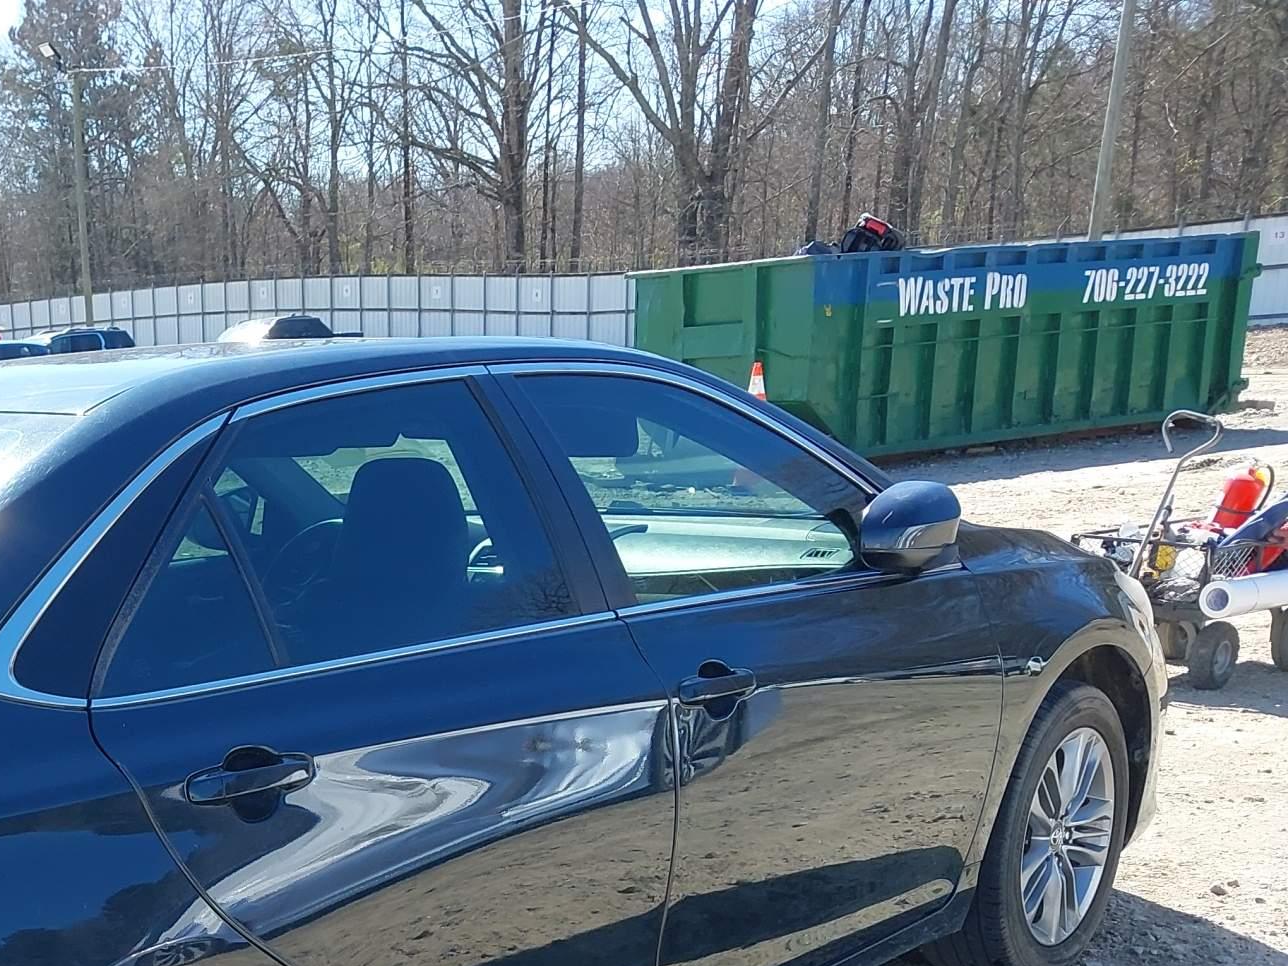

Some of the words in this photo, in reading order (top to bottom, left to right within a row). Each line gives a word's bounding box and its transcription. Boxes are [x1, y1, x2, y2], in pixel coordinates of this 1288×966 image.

[898, 275, 977, 317] WASTE
[984, 271, 1028, 310] PRO
[1082, 262, 1210, 304] 706-227-3222
